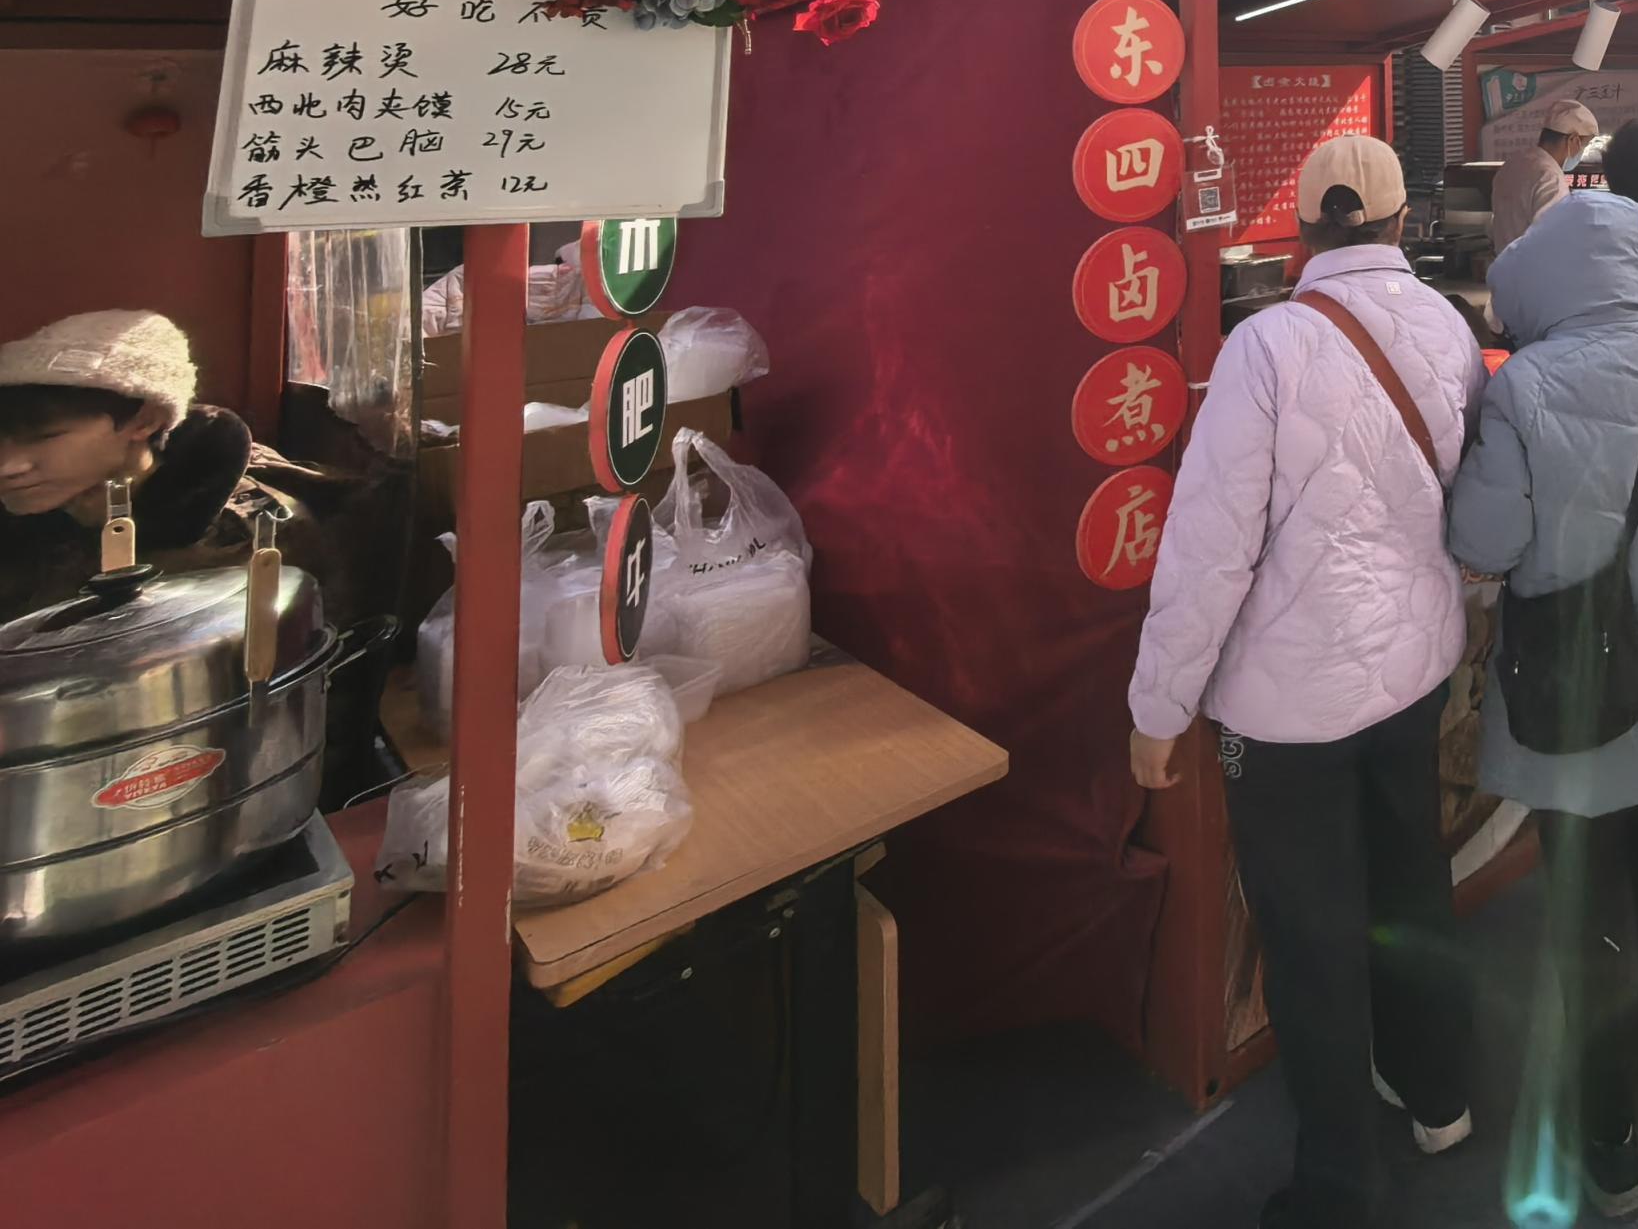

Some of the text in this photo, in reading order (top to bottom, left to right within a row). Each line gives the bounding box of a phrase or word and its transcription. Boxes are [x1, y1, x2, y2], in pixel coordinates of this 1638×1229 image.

[257, 39, 566, 80] 麻辣烫 28元
[248, 87, 551, 121] 西北肉夹馍 15元
[242, 129, 546, 164] 筋头巴脑 29元
[236, 170, 548, 210] 香橙热红茶 12元
[1100, 5, 1166, 581] 东四卤煮店
